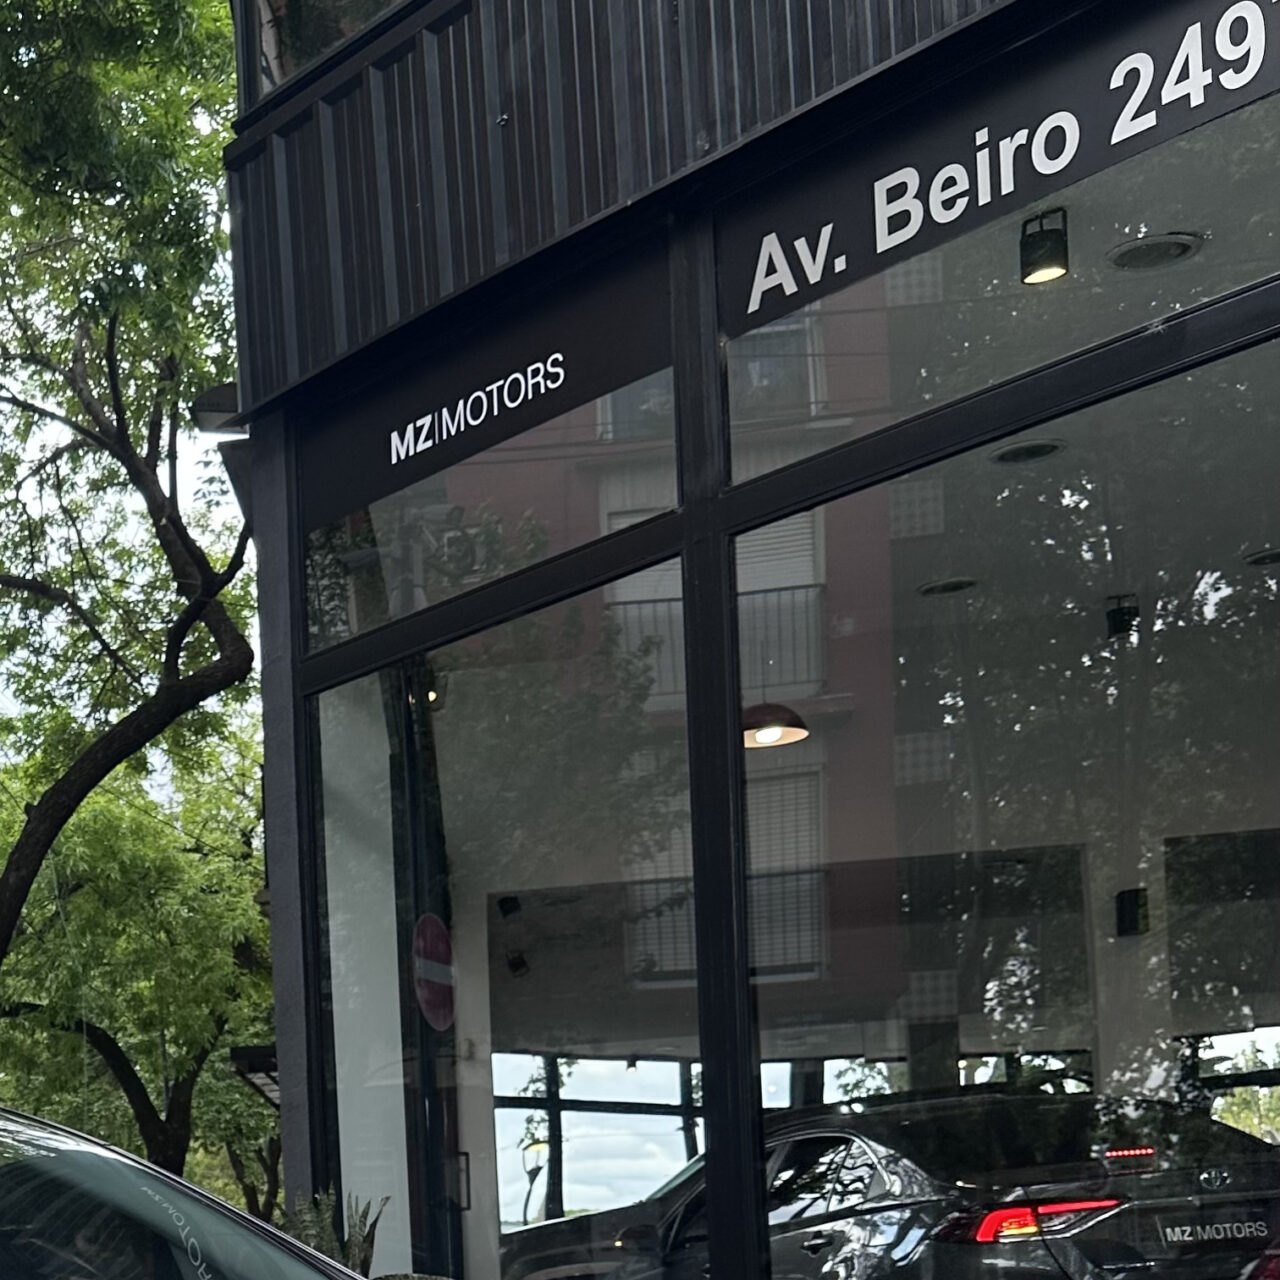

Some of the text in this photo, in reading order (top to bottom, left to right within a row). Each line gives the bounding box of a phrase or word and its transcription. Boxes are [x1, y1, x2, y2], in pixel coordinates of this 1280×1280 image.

[746, 0, 1280, 314] Av. Beiro 249
